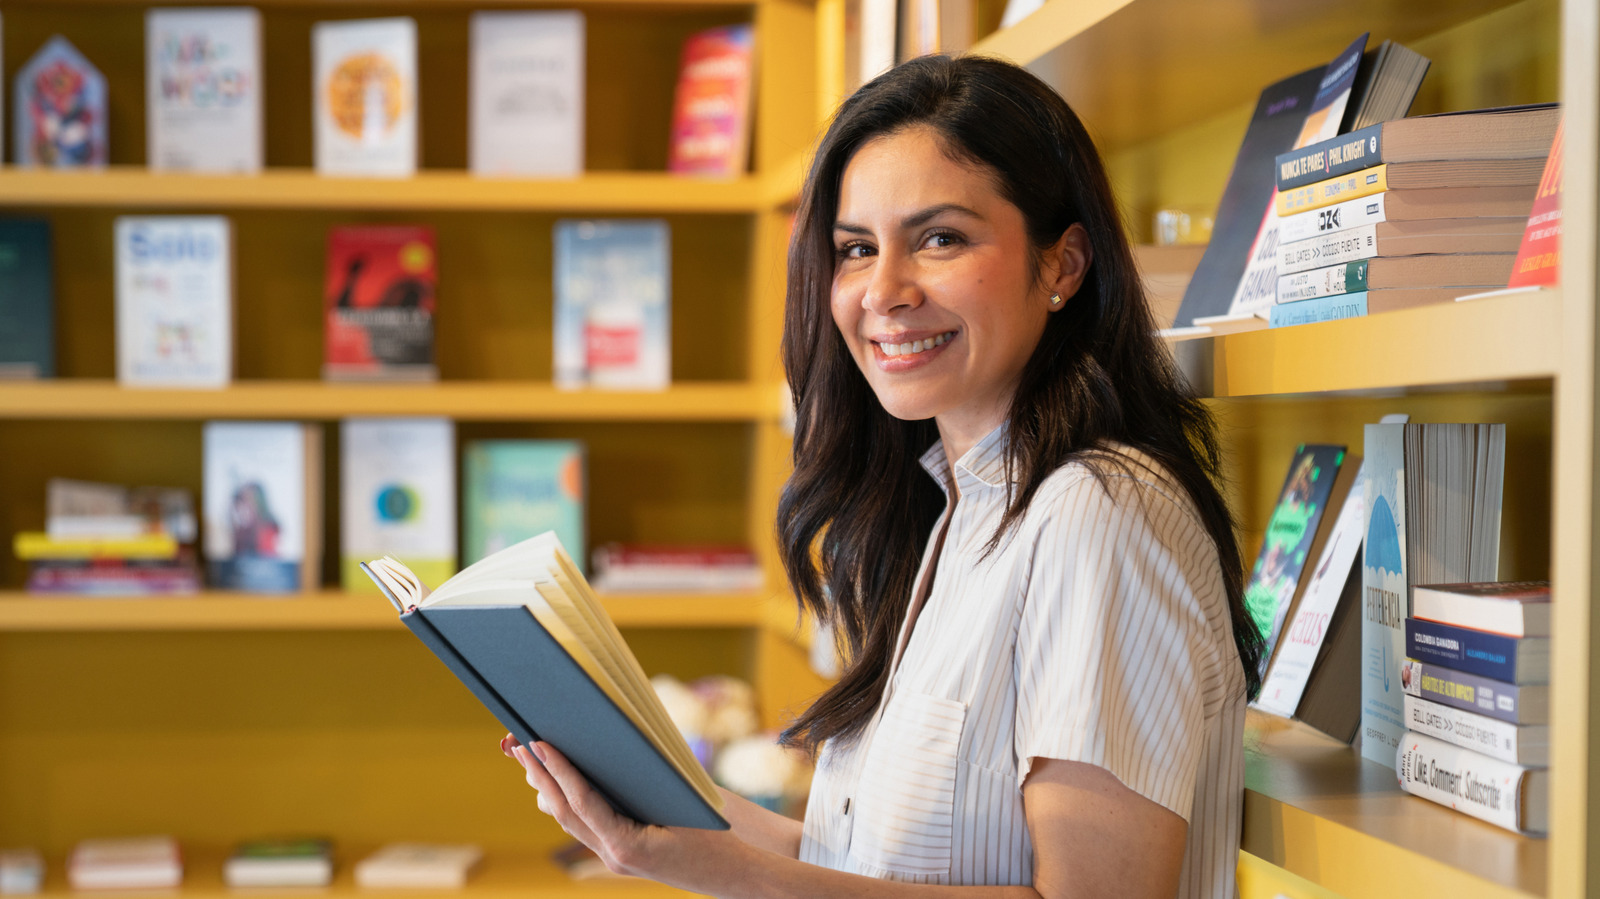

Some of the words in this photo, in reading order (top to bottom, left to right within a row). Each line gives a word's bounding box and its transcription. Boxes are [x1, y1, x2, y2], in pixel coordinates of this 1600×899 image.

[1281, 161, 1300, 180] NUNCA
[1300, 157, 1307, 175] TE
[1307, 152, 1324, 173] PARES
[1329, 146, 1342, 167] PHIL
[1343, 139, 1365, 163] KNIGHT
[1285, 253, 1295, 266] BILL
[1296, 249, 1311, 264] GATES
[1341, 238, 1360, 254] FUENTE
[1295, 274, 1308, 287] JUSTO
[1337, 268, 1346, 278] RYA
[1290, 611, 1329, 647] exus
[1415, 633, 1435, 647] COLOMBIA
[1456, 684, 1475, 704] IMPACTO
[1413, 708, 1425, 725] BILL
[1426, 712, 1442, 730] GATES
[1476, 728, 1498, 748] FUENTE
[1414, 753, 1430, 790] Like,
[1430, 759, 1464, 799] Comment,
[1465, 771, 1501, 811] Subscribe
